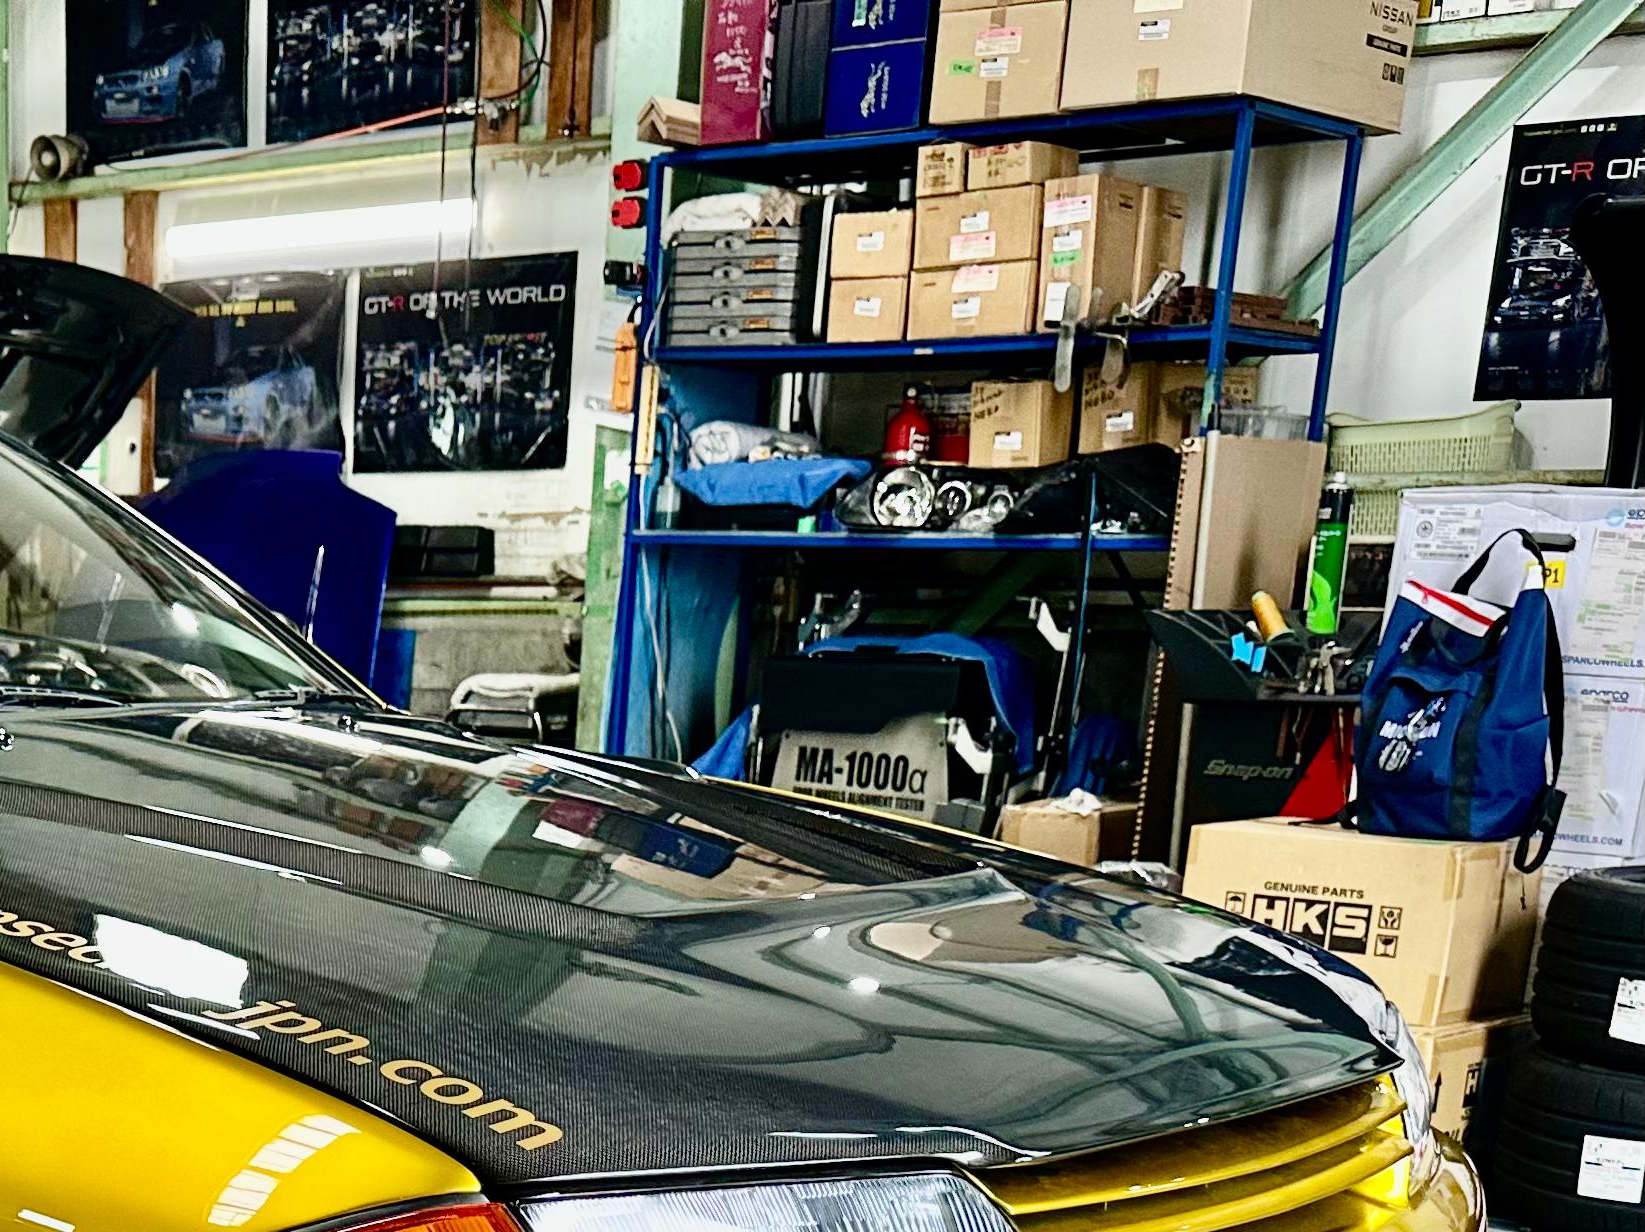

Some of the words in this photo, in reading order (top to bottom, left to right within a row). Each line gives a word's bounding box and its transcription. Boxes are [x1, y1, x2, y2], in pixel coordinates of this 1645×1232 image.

[1369, 1, 1415, 28] NISSAN
[1519, 161, 1595, 186] GT-R
[364, 294, 405, 316] GT-R
[486, 284, 566, 306] WORLD
[1264, 881, 1319, 896] GENUINE
[1321, 886, 1365, 900] PARTS
[1253, 895, 1372, 950] HKS
